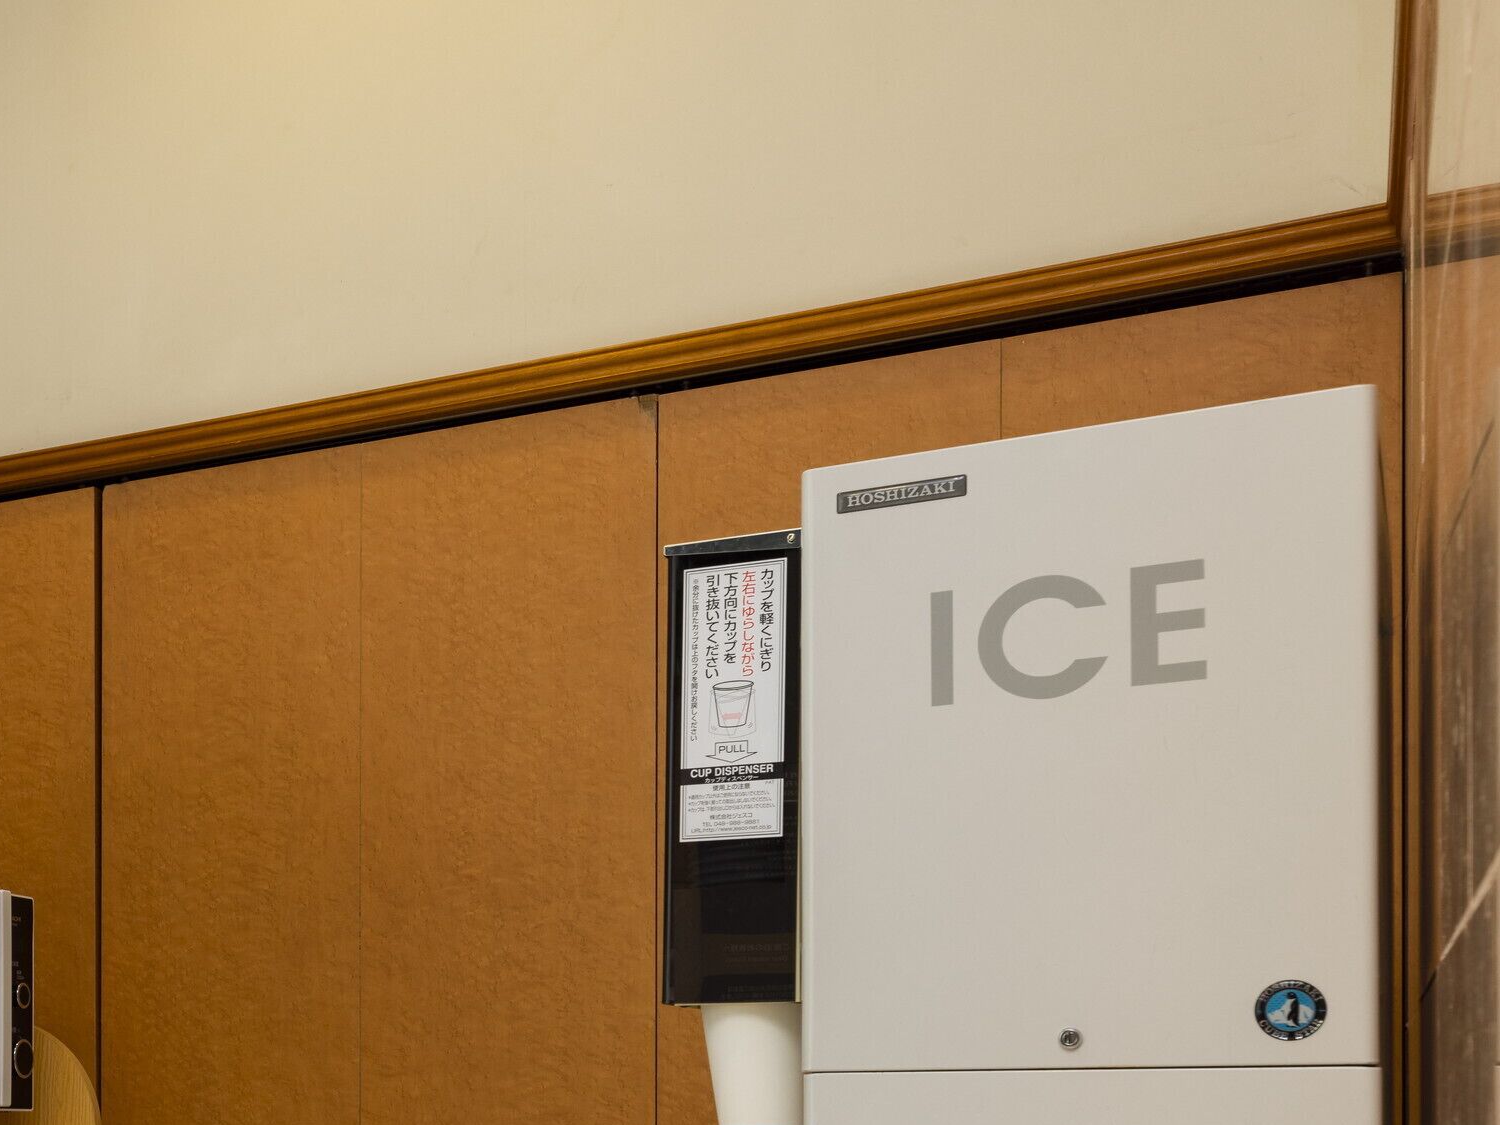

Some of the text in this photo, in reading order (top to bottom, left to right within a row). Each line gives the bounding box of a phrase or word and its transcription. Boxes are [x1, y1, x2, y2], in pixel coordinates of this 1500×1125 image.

[846, 480, 957, 508] HOSHIZAKI
[705, 574, 721, 679] 引き抜いてください
[723, 571, 739, 664] 下方向にカップを
[741, 570, 757, 677] 左右にゆらしながら
[759, 568, 774, 672] カップを軽くにぎり
[930, 558, 1208, 708] ICE
[690, 764, 774, 778] CUP DISPENSER
[718, 744, 746, 754] PULL
[704, 775, 760, 784] カップディスペンサー
[712, 783, 751, 792] 使用上の注意
